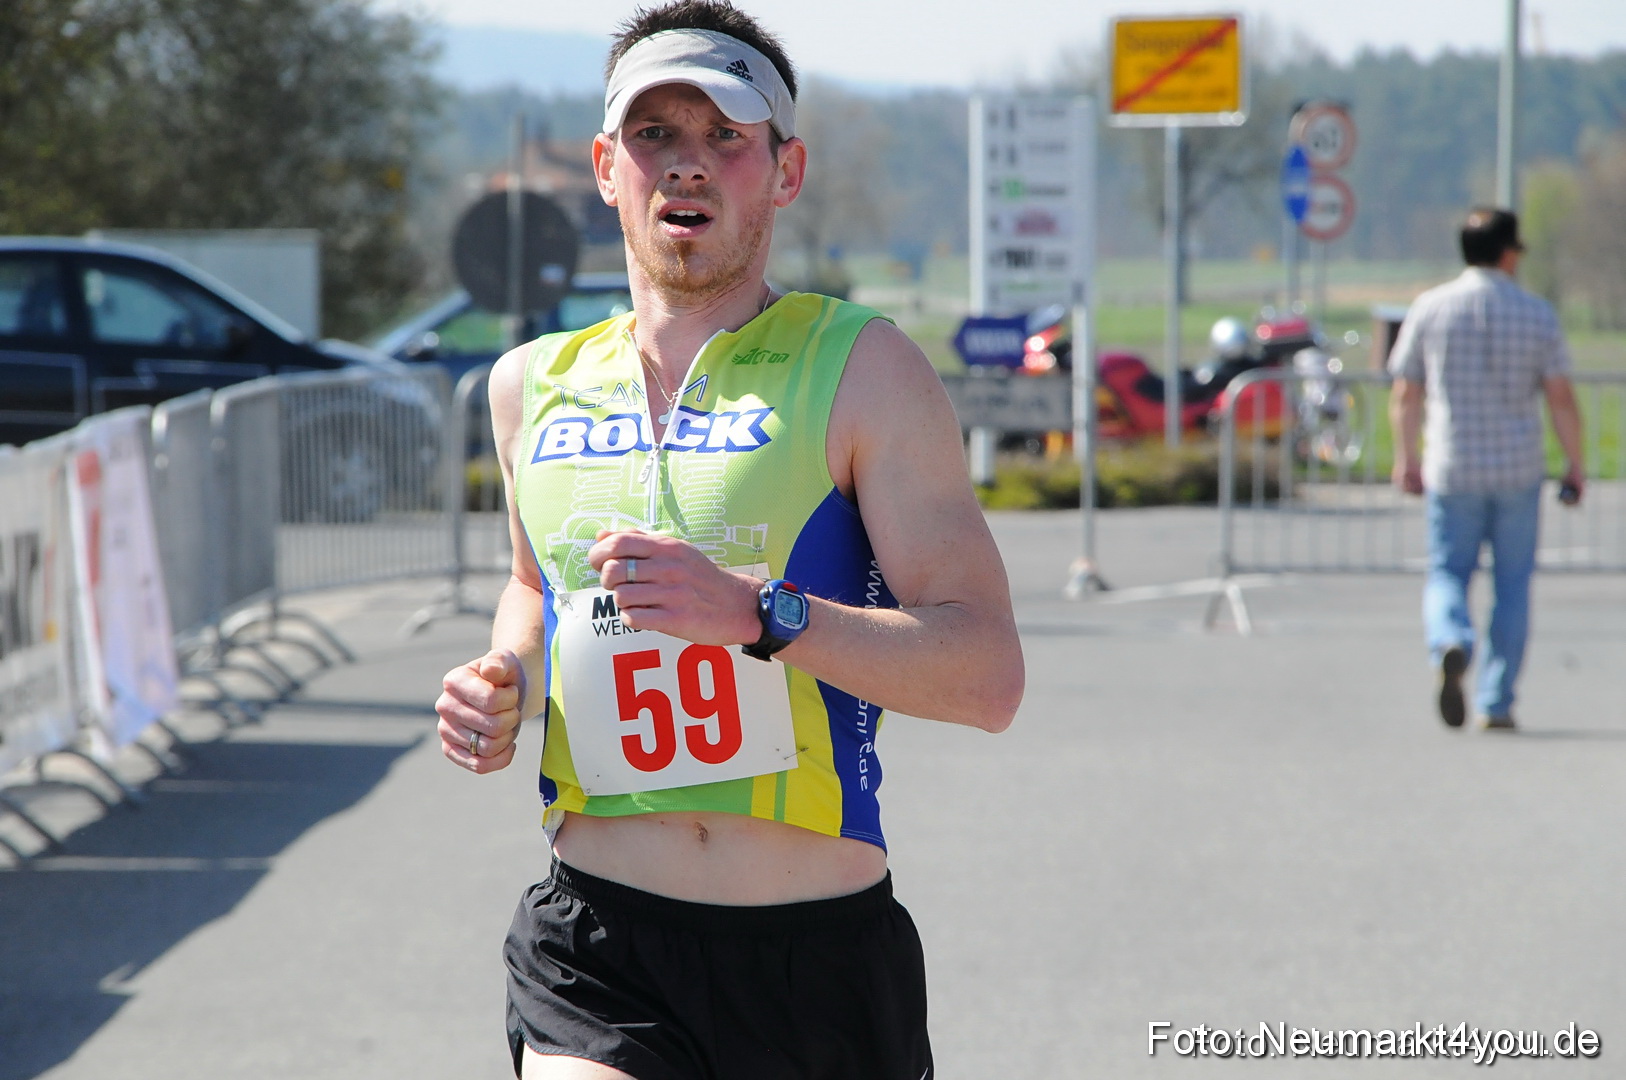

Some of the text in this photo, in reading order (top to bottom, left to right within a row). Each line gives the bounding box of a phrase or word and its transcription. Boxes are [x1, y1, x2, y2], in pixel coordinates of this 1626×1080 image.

[726, 65, 753, 82] adidas
[531, 406, 775, 464] BOCK
[613, 642, 743, 772] 59
